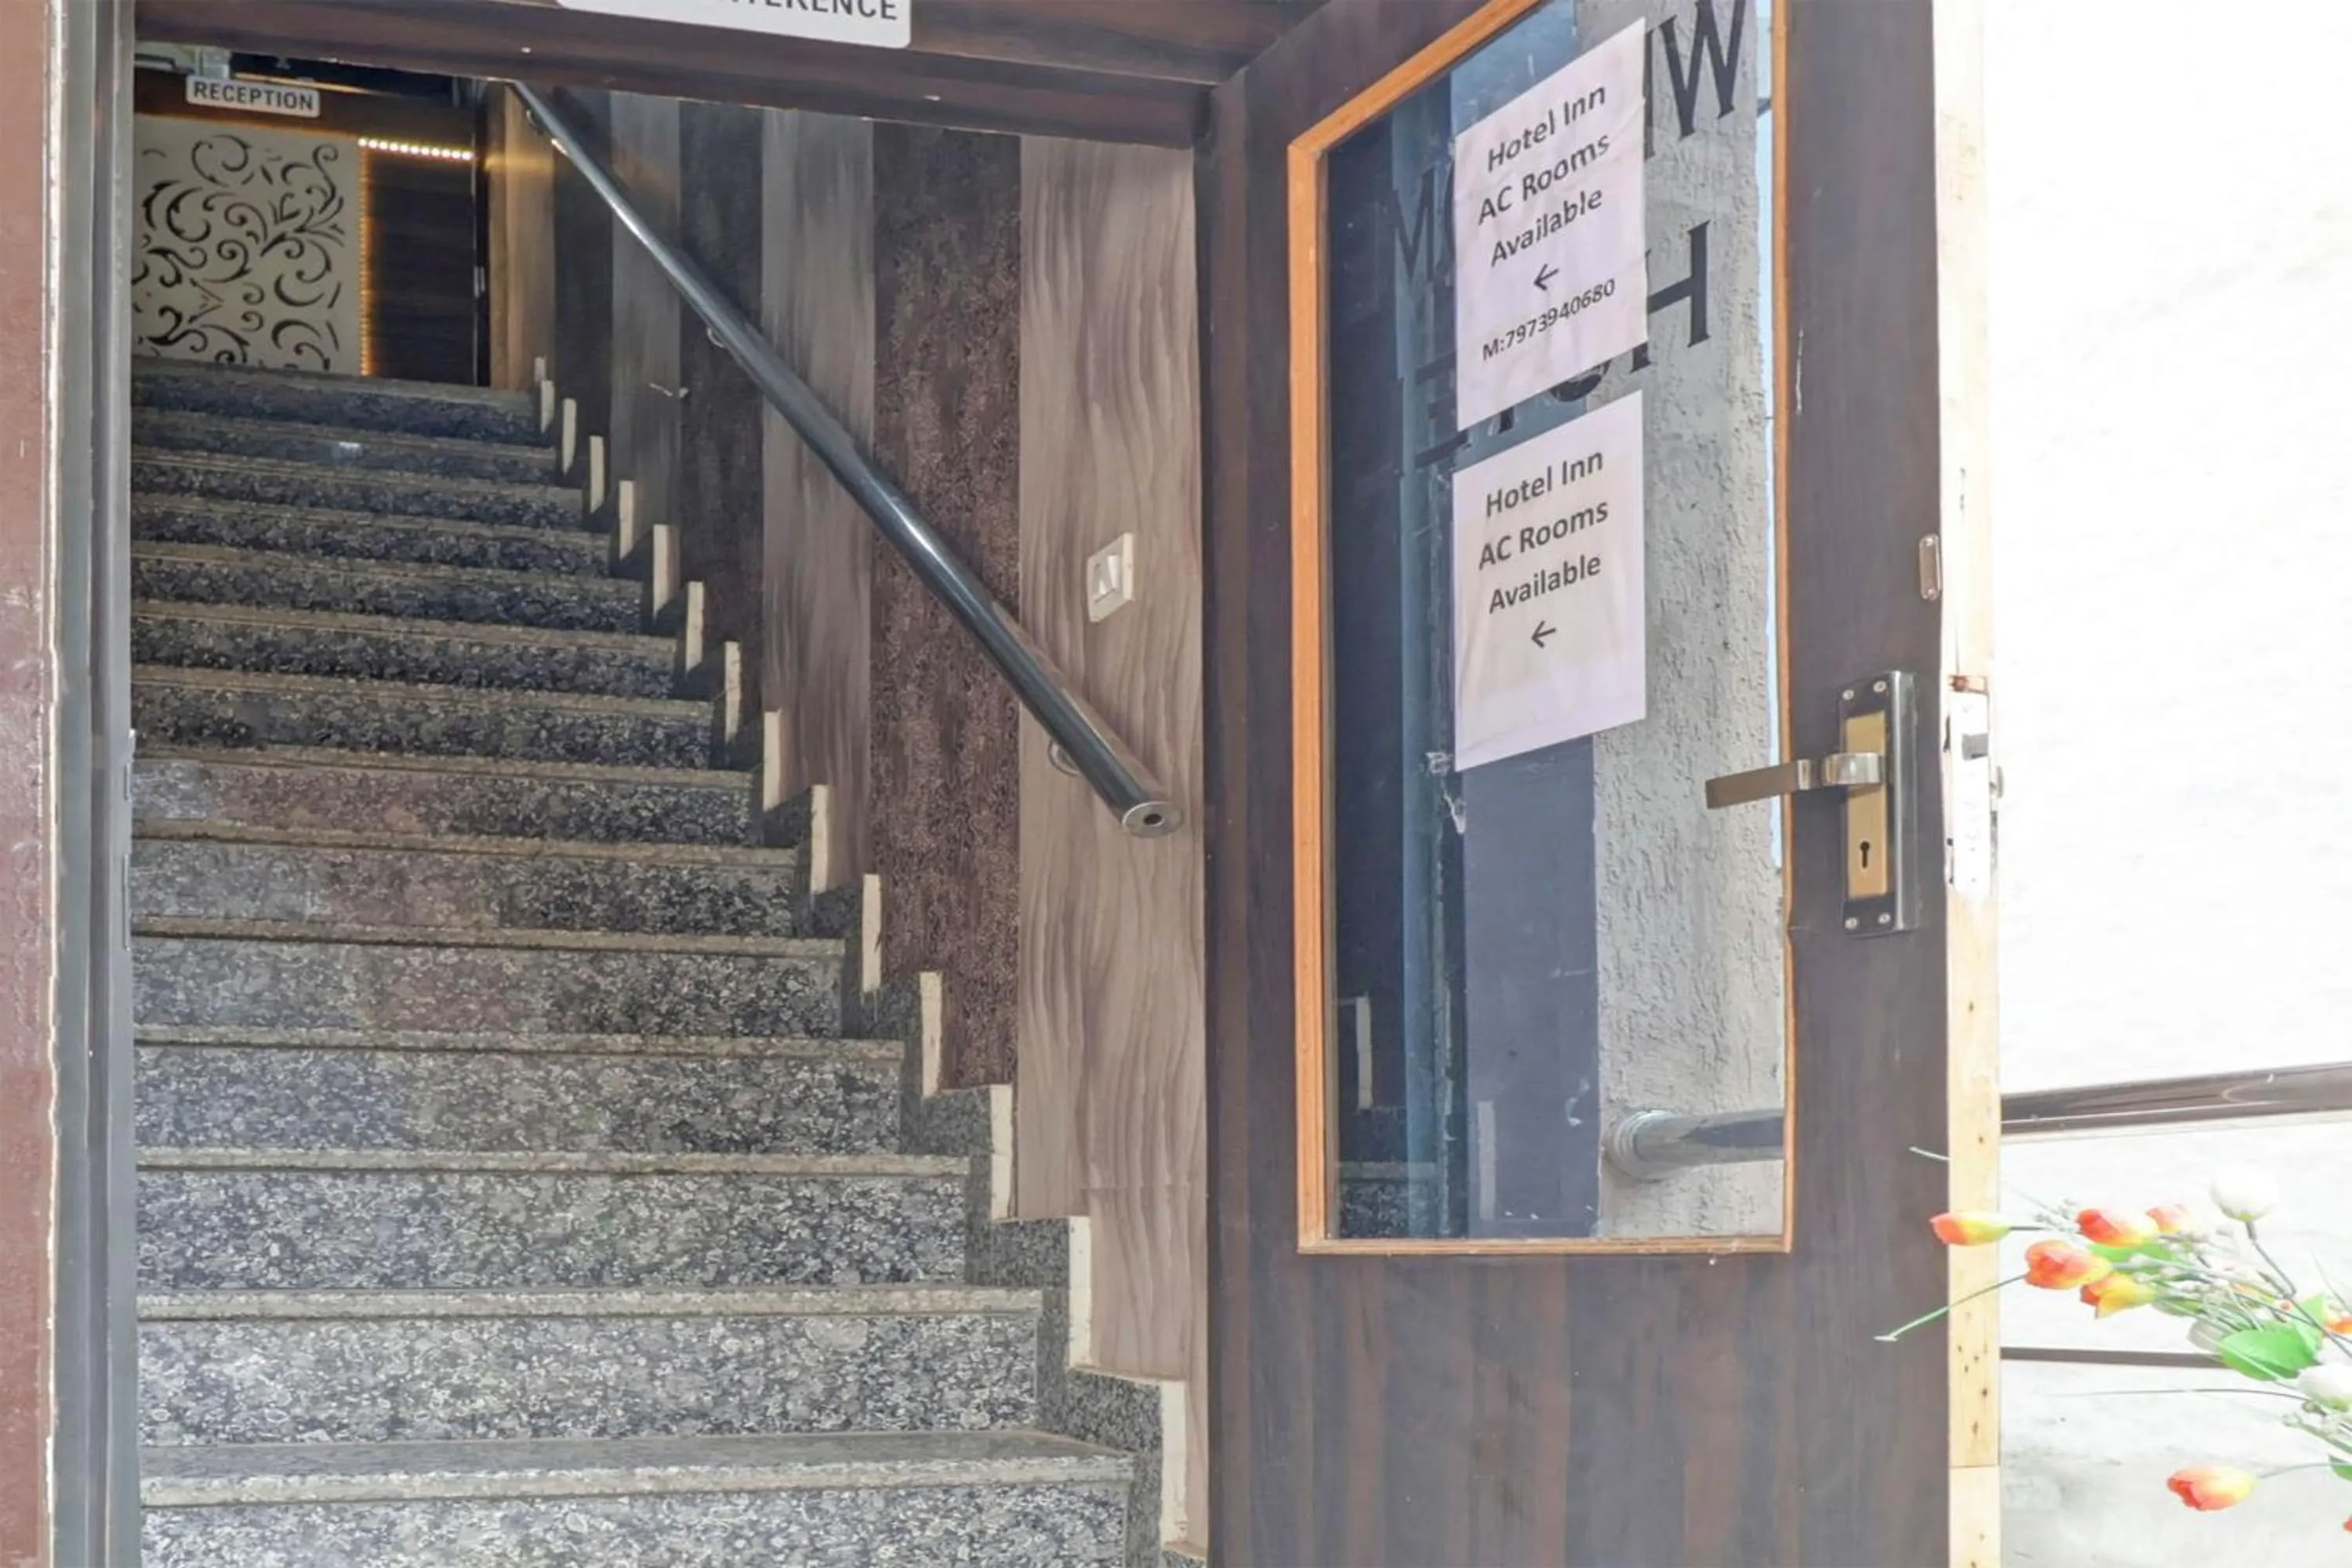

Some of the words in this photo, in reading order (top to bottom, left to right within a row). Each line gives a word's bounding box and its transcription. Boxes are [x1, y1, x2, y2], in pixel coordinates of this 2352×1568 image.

[193, 81, 314, 111] RECEPTION
[1486, 109, 1555, 172] Hotel
[1563, 85, 1606, 127] Inn
[1478, 184, 1512, 226] AC
[1522, 133, 1610, 201] Rooms
[1490, 188, 1603, 267] Available
[1483, 278, 1616, 361] M:7973940680
[1485, 466, 1553, 517] Hotel
[1562, 449, 1604, 487] Inn
[1478, 535, 1512, 570] AC
[1519, 499, 1609, 554] Rooms
[1489, 554, 1602, 614] Available
